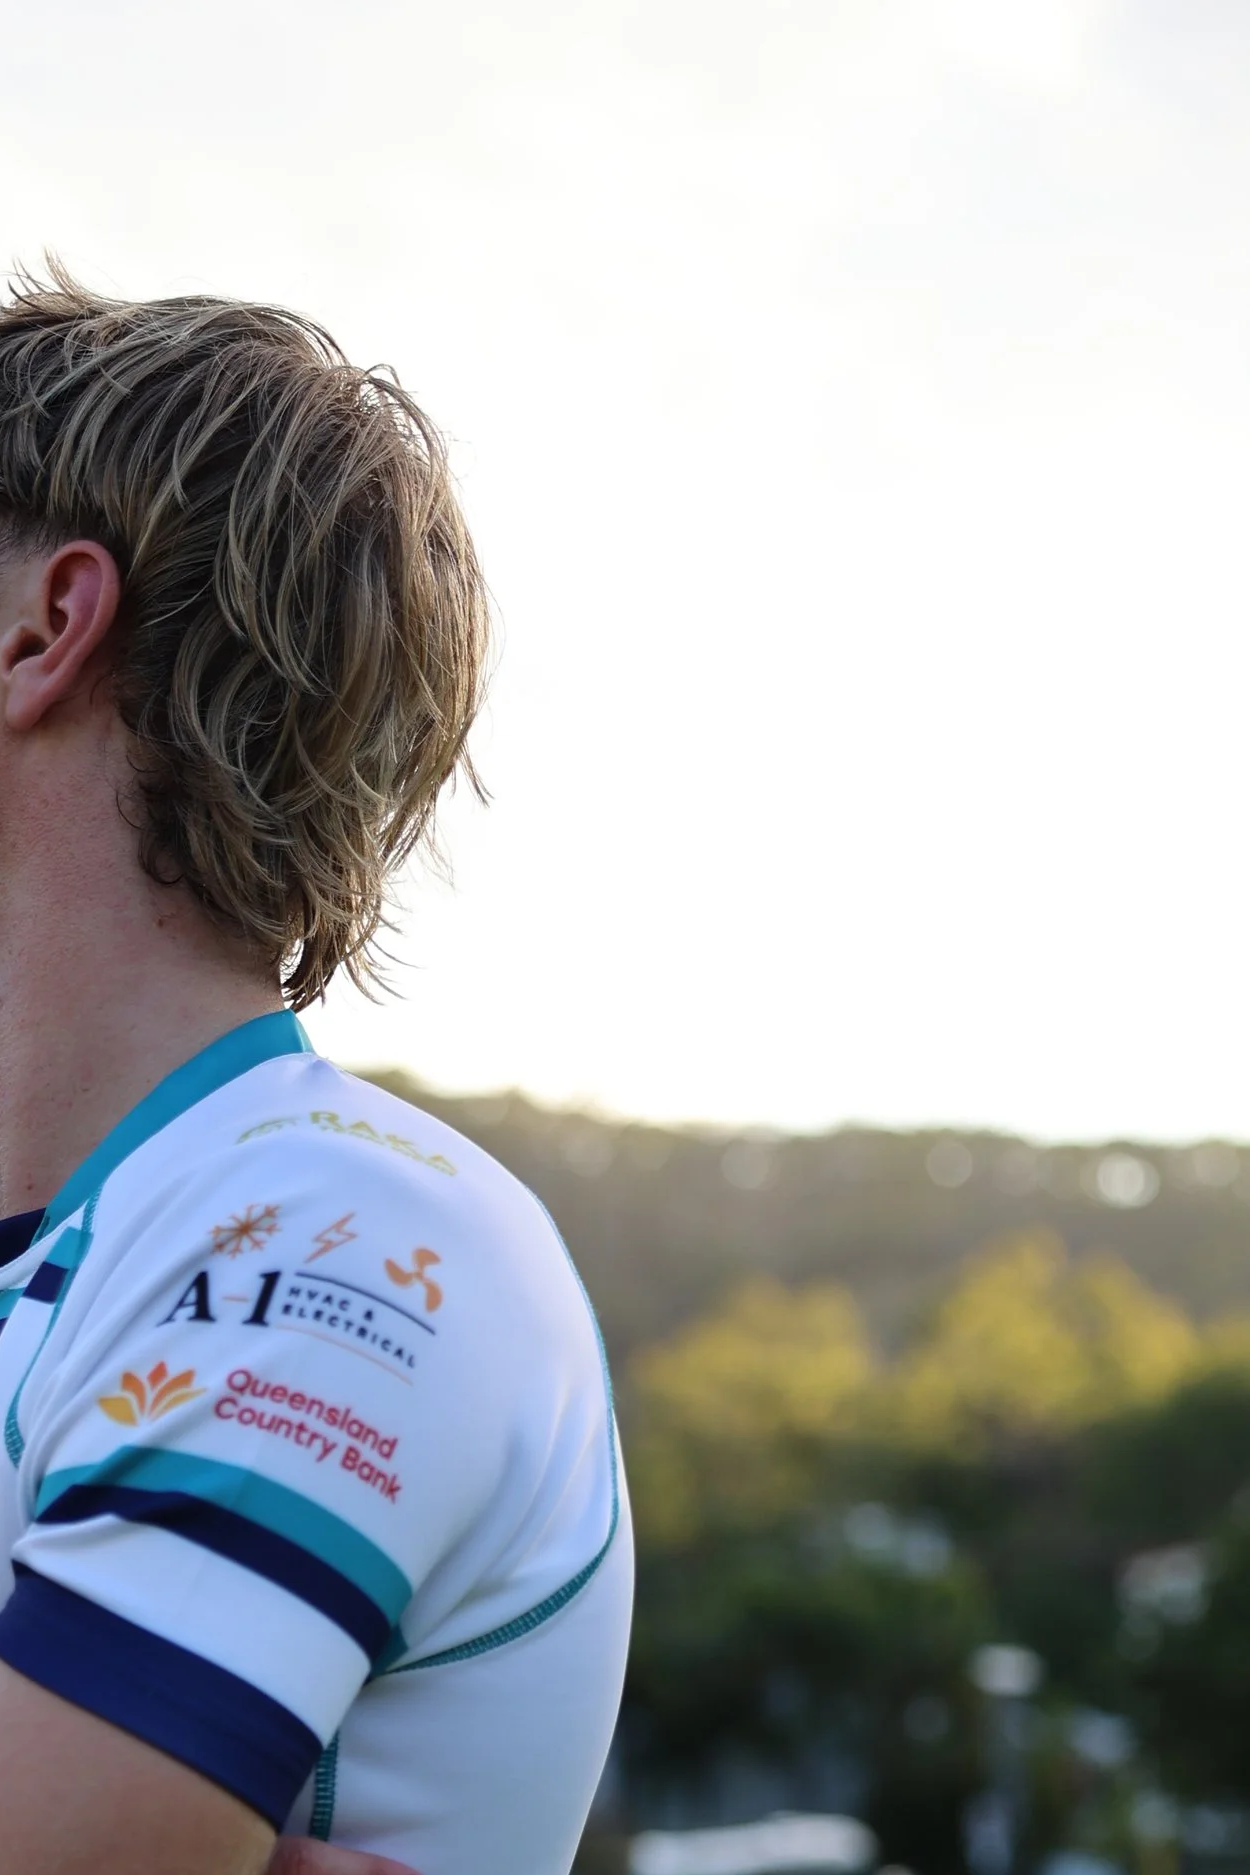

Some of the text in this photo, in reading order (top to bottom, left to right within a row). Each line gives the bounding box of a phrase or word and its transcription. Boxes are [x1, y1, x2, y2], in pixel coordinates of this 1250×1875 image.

[281, 1303, 415, 1369] ELECTRICAL
[289, 1286, 374, 1322] HVAC &
[214, 1396, 402, 1504] Country Bank
[227, 1369, 399, 1460] Queensland
